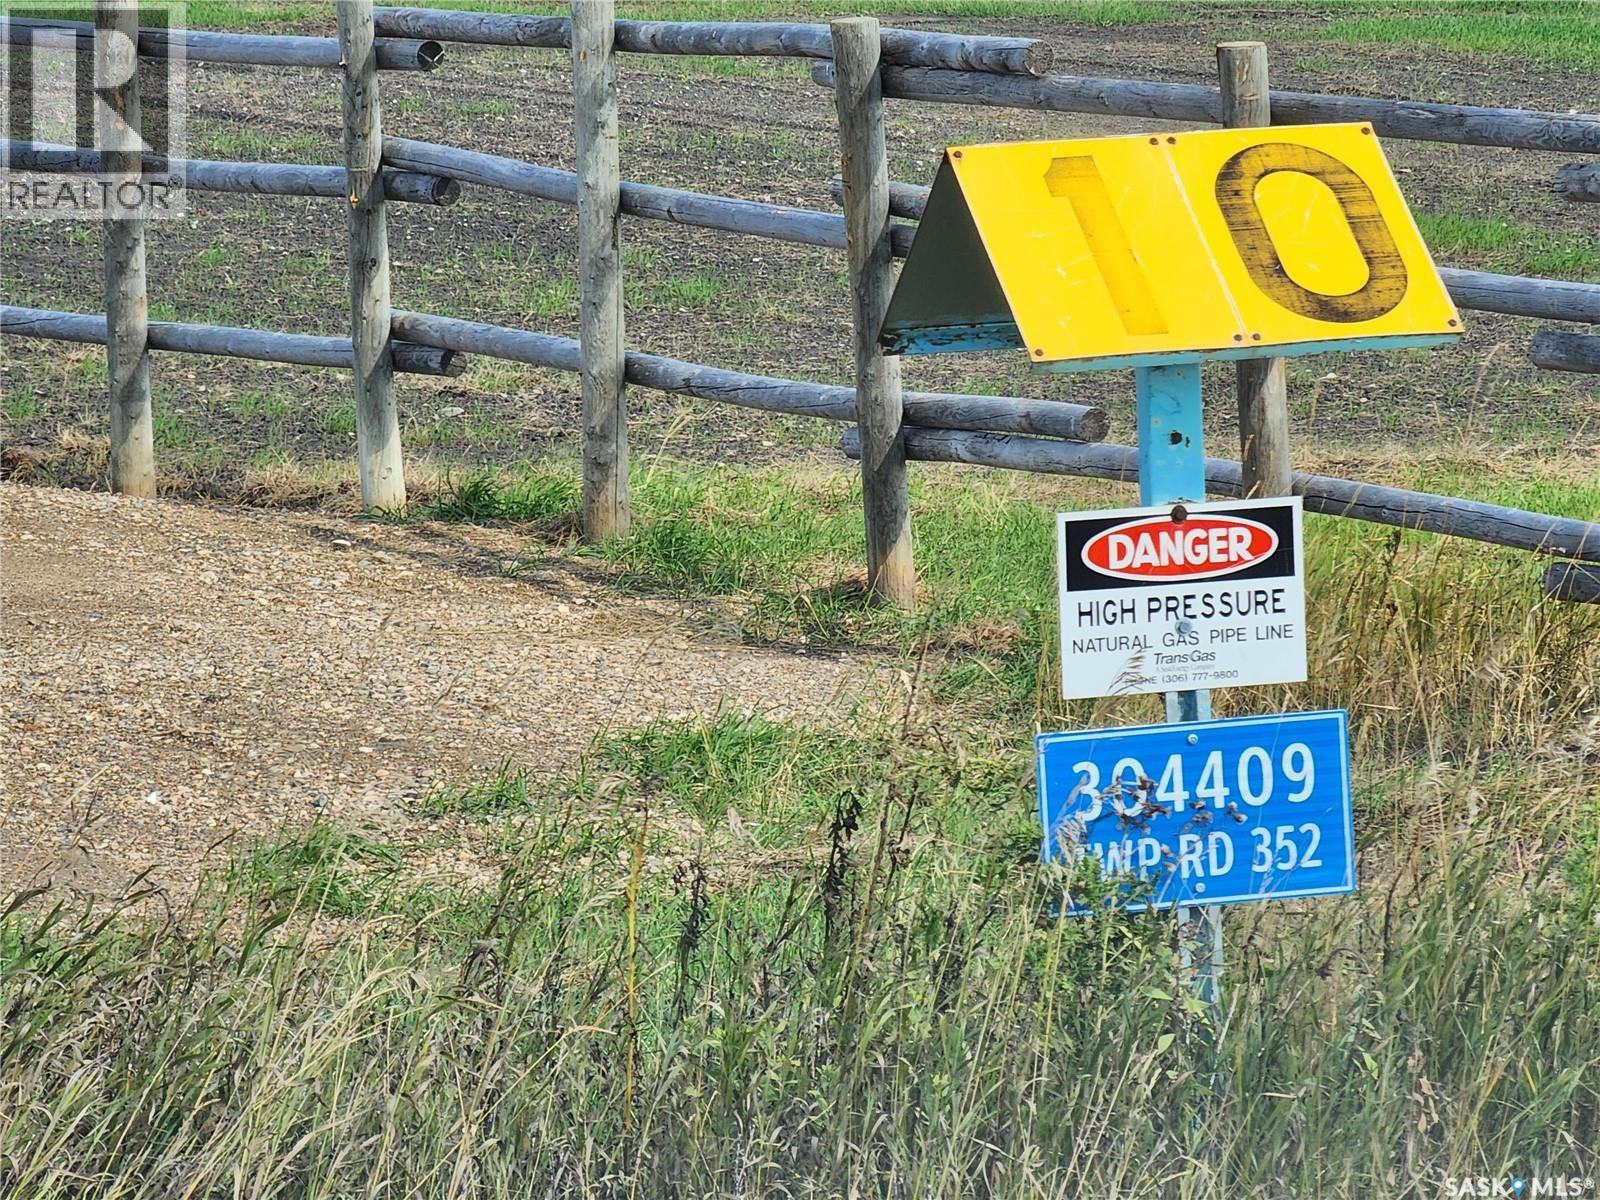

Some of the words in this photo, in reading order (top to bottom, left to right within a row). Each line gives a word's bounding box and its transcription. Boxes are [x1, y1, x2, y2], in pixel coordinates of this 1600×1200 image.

[1043, 142, 1408, 335] 10
[1108, 526, 1255, 570] DANGER
[1078, 599, 1136, 627] HIGH
[1147, 588, 1286, 623] PRESSURE
[1072, 634, 1153, 654] NATURAL
[1162, 631, 1200, 648] GAS
[1210, 627, 1247, 644] PIPE
[1255, 624, 1294, 640] LINE
[1162, 674, 1188, 684] (306)
[1192, 670, 1239, 681] 777-9800
[1072, 742, 1315, 821] 304409
[1179, 831, 1234, 879] RD
[1250, 822, 1322, 873] 352
